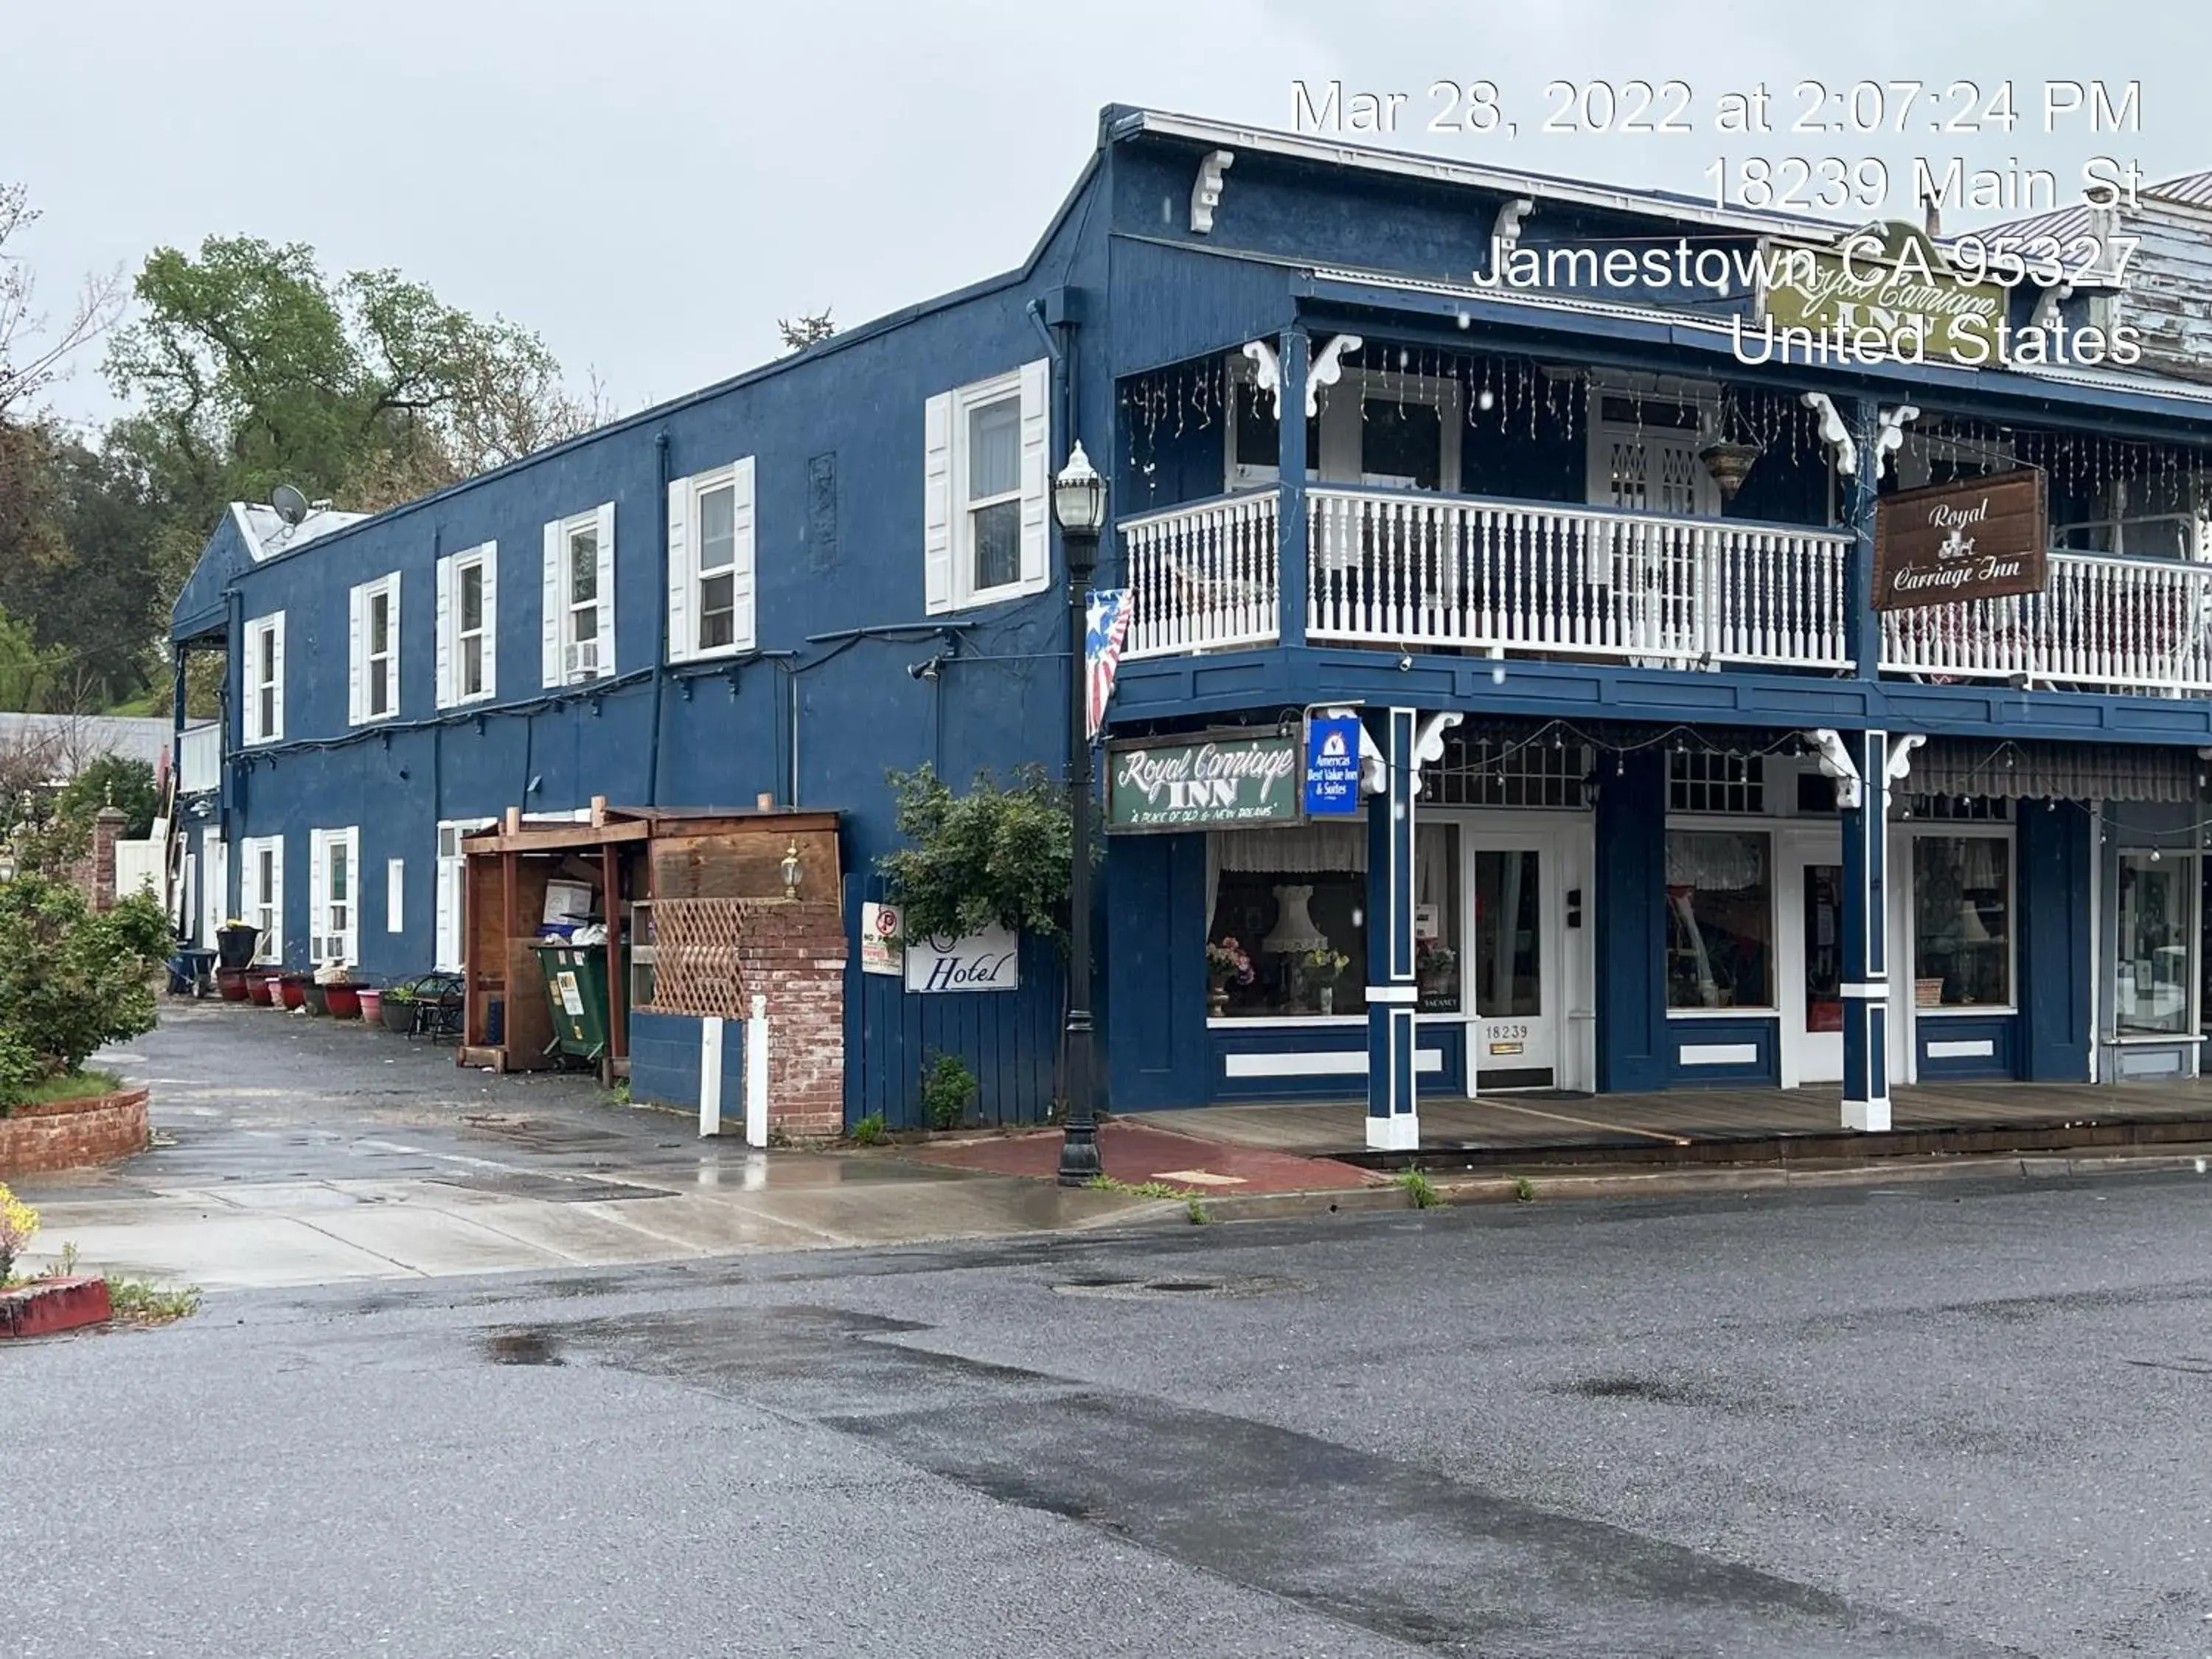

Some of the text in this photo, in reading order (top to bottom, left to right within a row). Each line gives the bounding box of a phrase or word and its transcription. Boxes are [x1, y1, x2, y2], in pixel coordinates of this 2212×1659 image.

[1928, 497, 1989, 531] Royal
[1893, 555, 2021, 591] Carriage Inn
[1118, 742, 1296, 804] Royal Carriage
[1307, 768, 1357, 781] Best Value Inn
[1166, 779, 1239, 809] INN
[1316, 782, 1347, 796] & Suites
[1182, 810, 1199, 822] OLD
[922, 951, 1015, 990] Hotel
[1486, 1026, 1528, 1039] 18239
